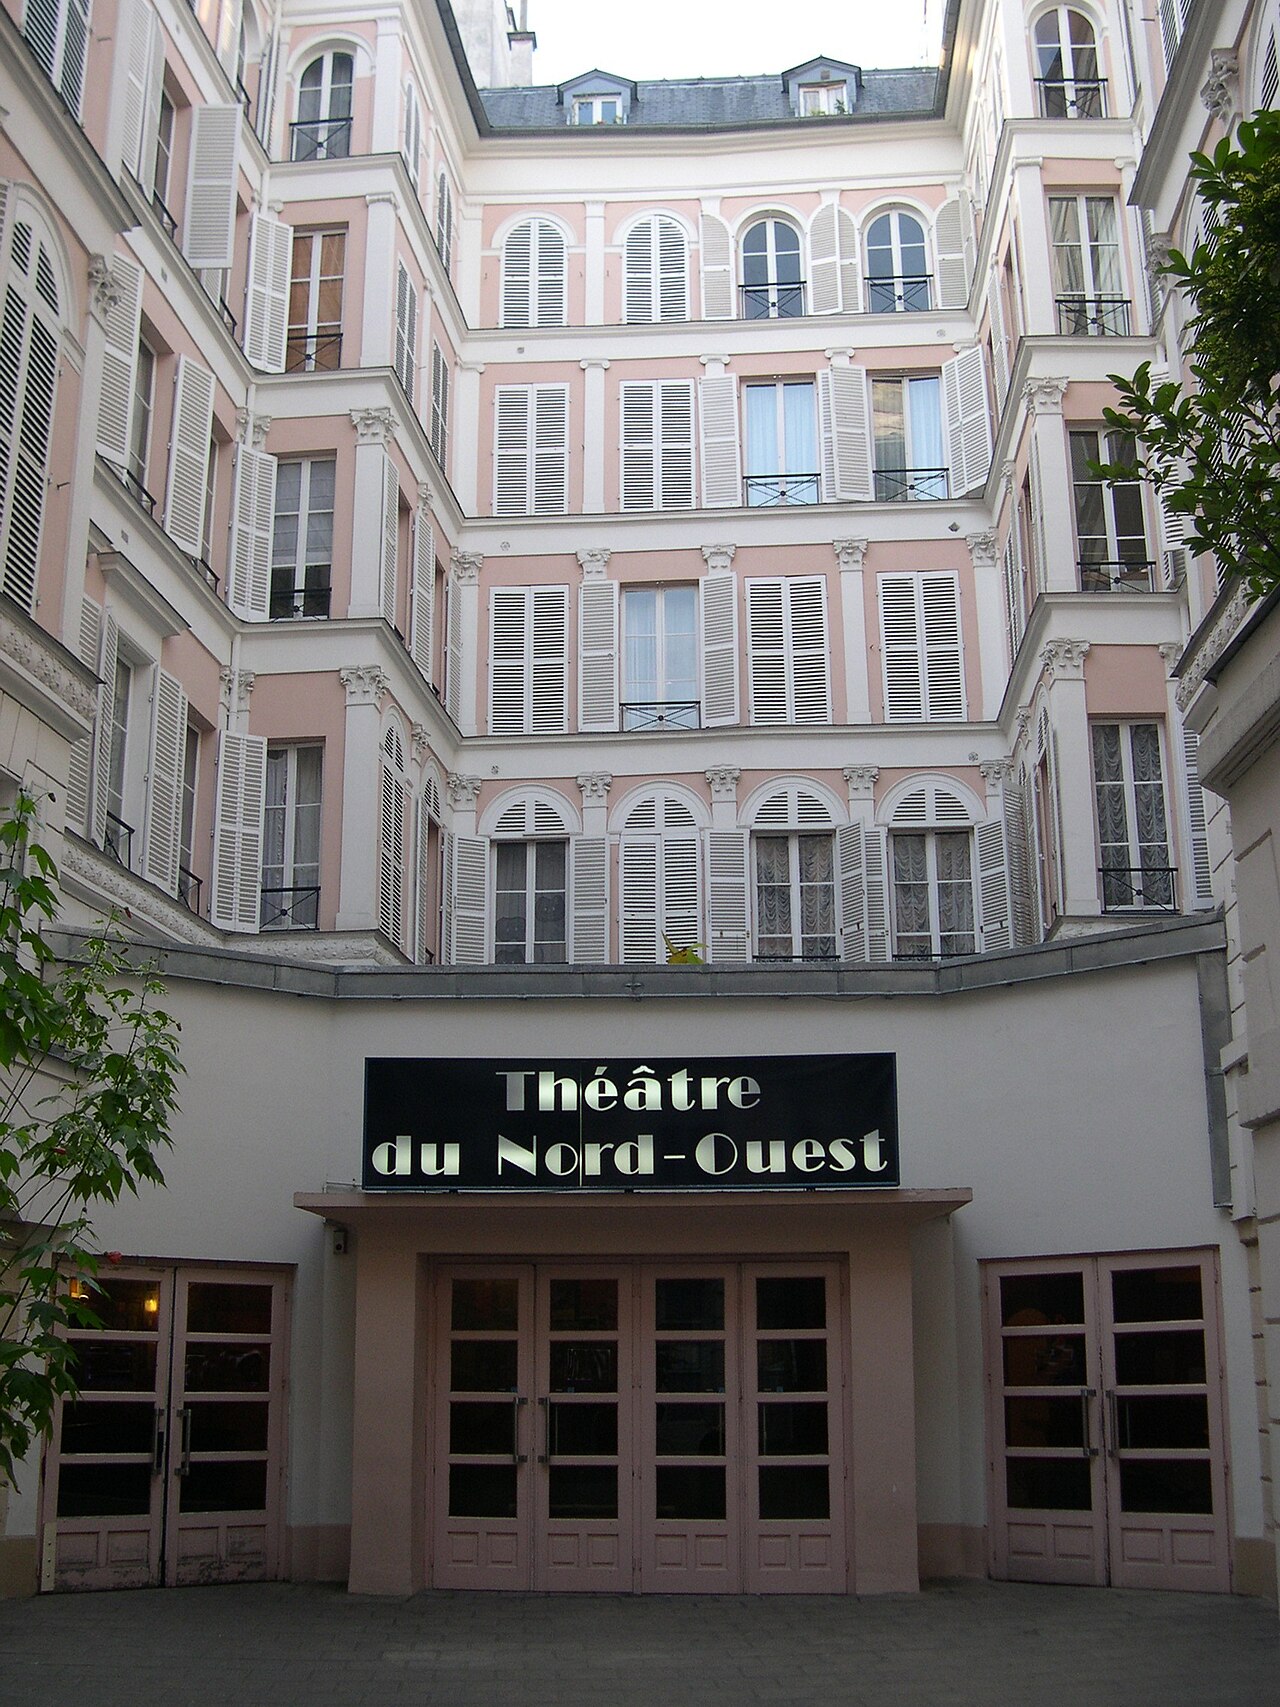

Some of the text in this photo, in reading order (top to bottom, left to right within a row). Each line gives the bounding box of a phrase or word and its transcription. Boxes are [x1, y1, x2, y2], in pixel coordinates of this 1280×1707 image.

[495, 1065, 761, 1112] Théâtre
[371, 1128, 889, 1176] du Nord-Ouest
